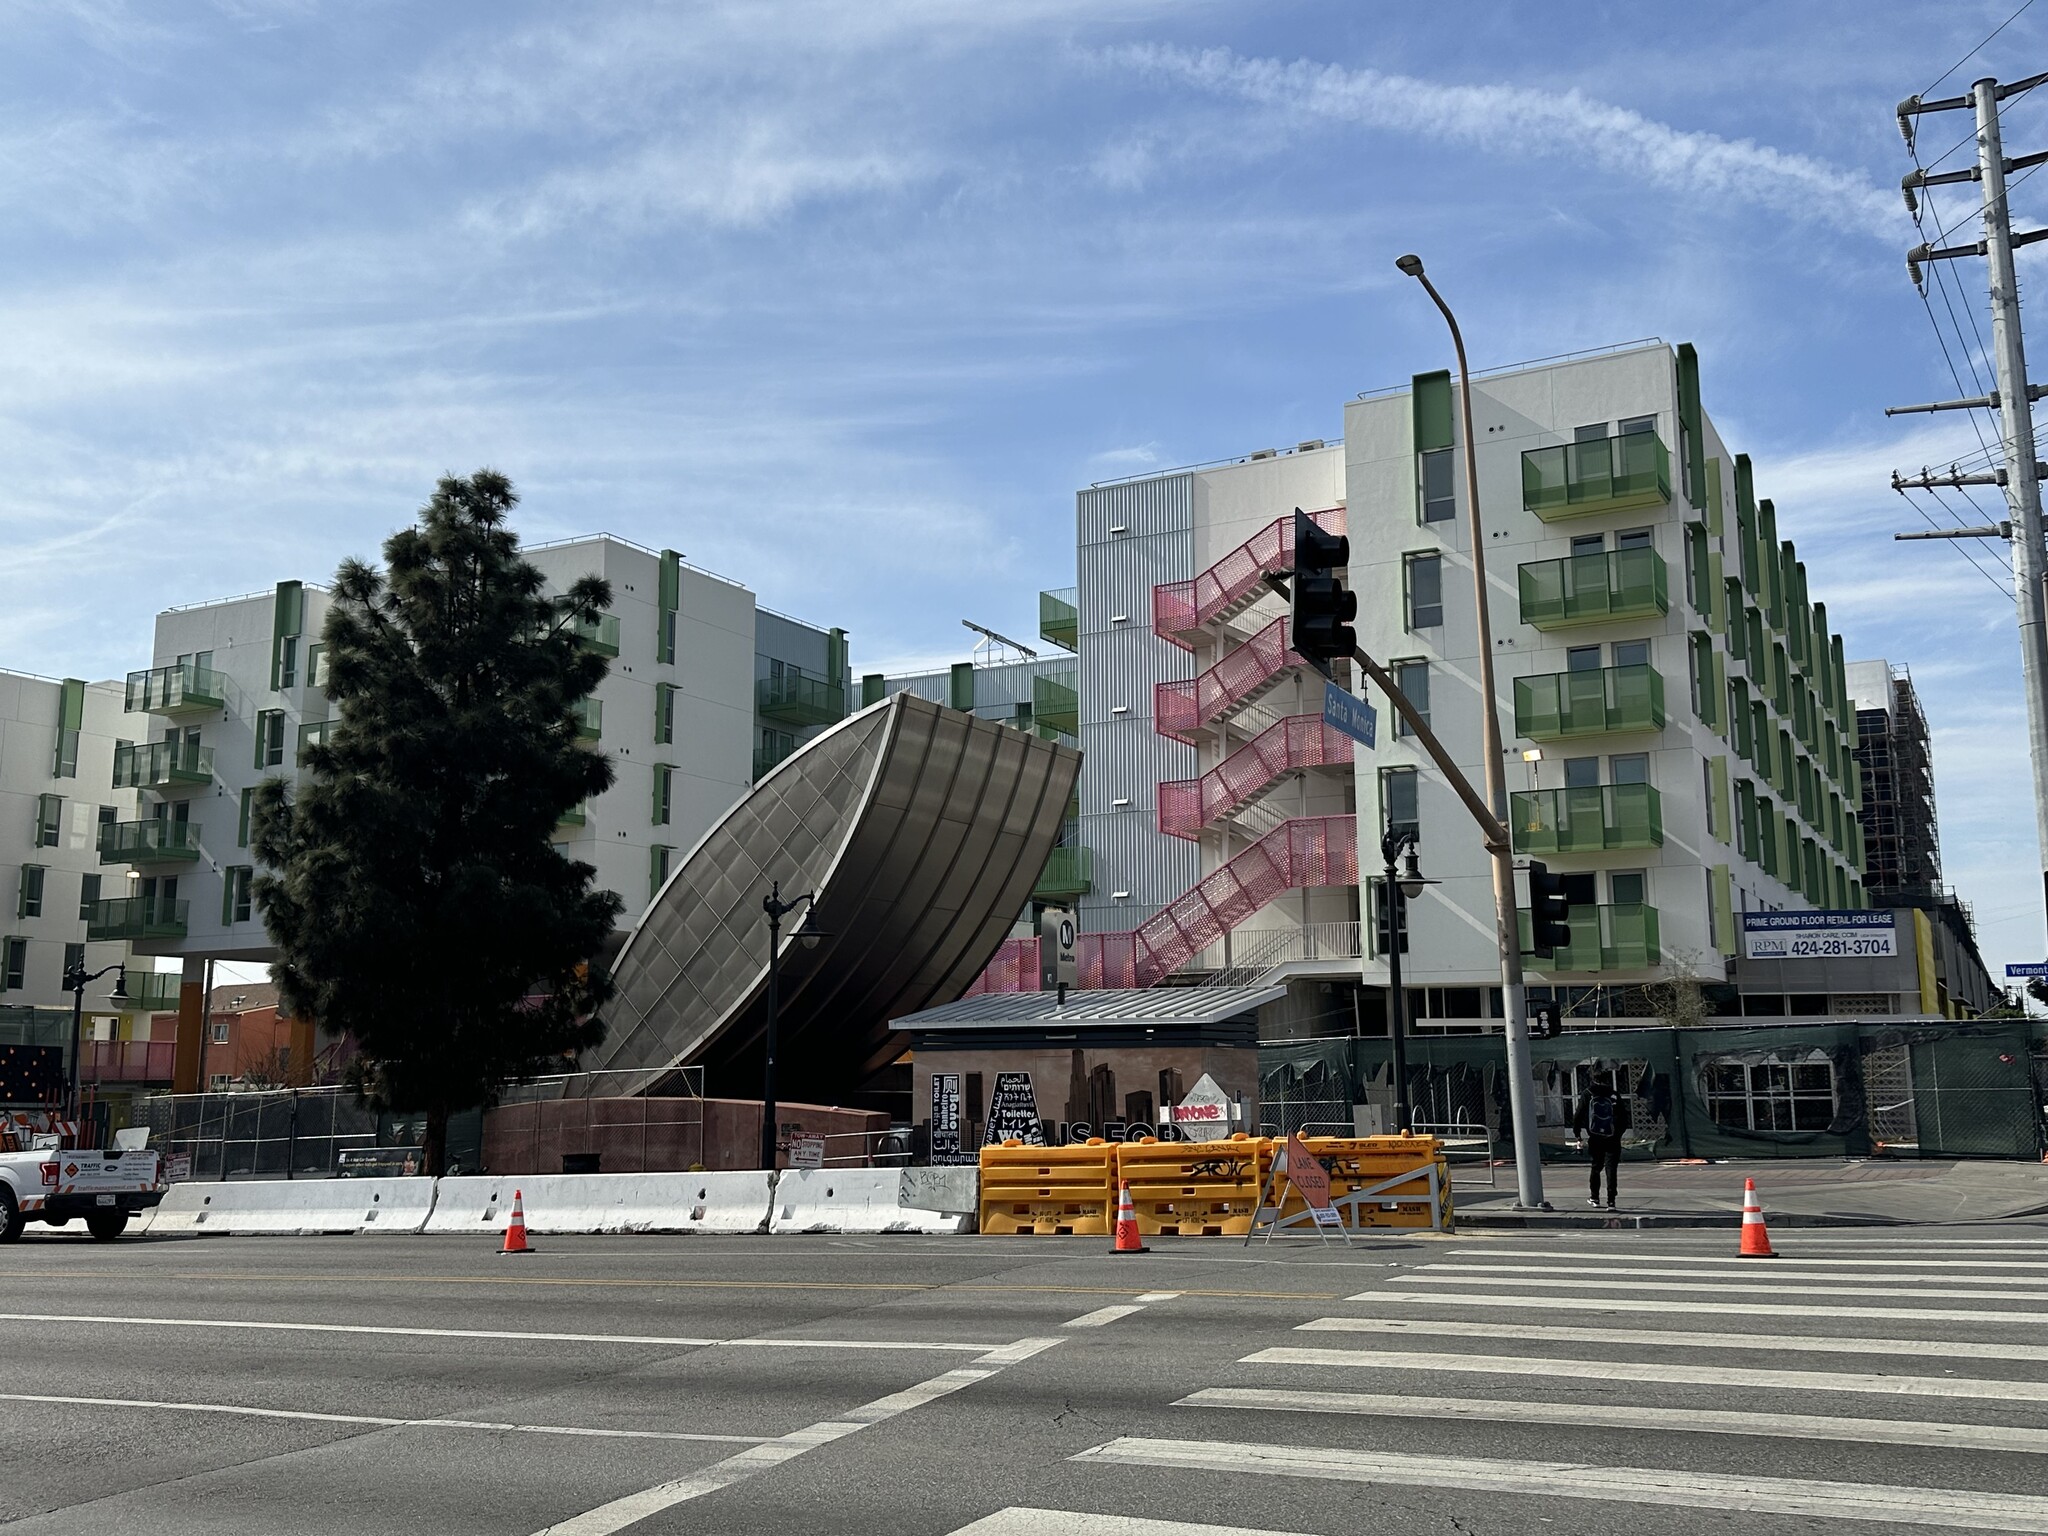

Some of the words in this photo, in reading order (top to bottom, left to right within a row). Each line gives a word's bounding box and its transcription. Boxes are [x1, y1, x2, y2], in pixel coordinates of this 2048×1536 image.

[1328, 693, 1348, 723] Santa
[1352, 708, 1373, 737] Monica
[1746, 918, 1768, 926] PRIME
[1770, 917, 1800, 926] GROUND
[1802, 916, 1825, 925] FLOOR
[1826, 916, 1850, 924] RETAIL
[1852, 915, 1867, 924] FOR
[1869, 914, 1892, 924] LEASE
[1754, 941, 1784, 951] RPM
[1792, 940, 1890, 955] 424-281-3704
[2010, 966, 2048, 975] Vermont
[1001, 1074, 1024, 1087] الحمام
[949, 1094, 959, 1130] Baño
[1002, 1119, 1026, 1128] トイレ
[998, 1130, 1023, 1142] WC
[1059, 1122, 1092, 1145] IS
[792, 1140, 800, 1148] NO
[934, 1139, 959, 1153] توالت
[1292, 1156, 1314, 1169] LANE
[1297, 1176, 1326, 1188] CLOSED
